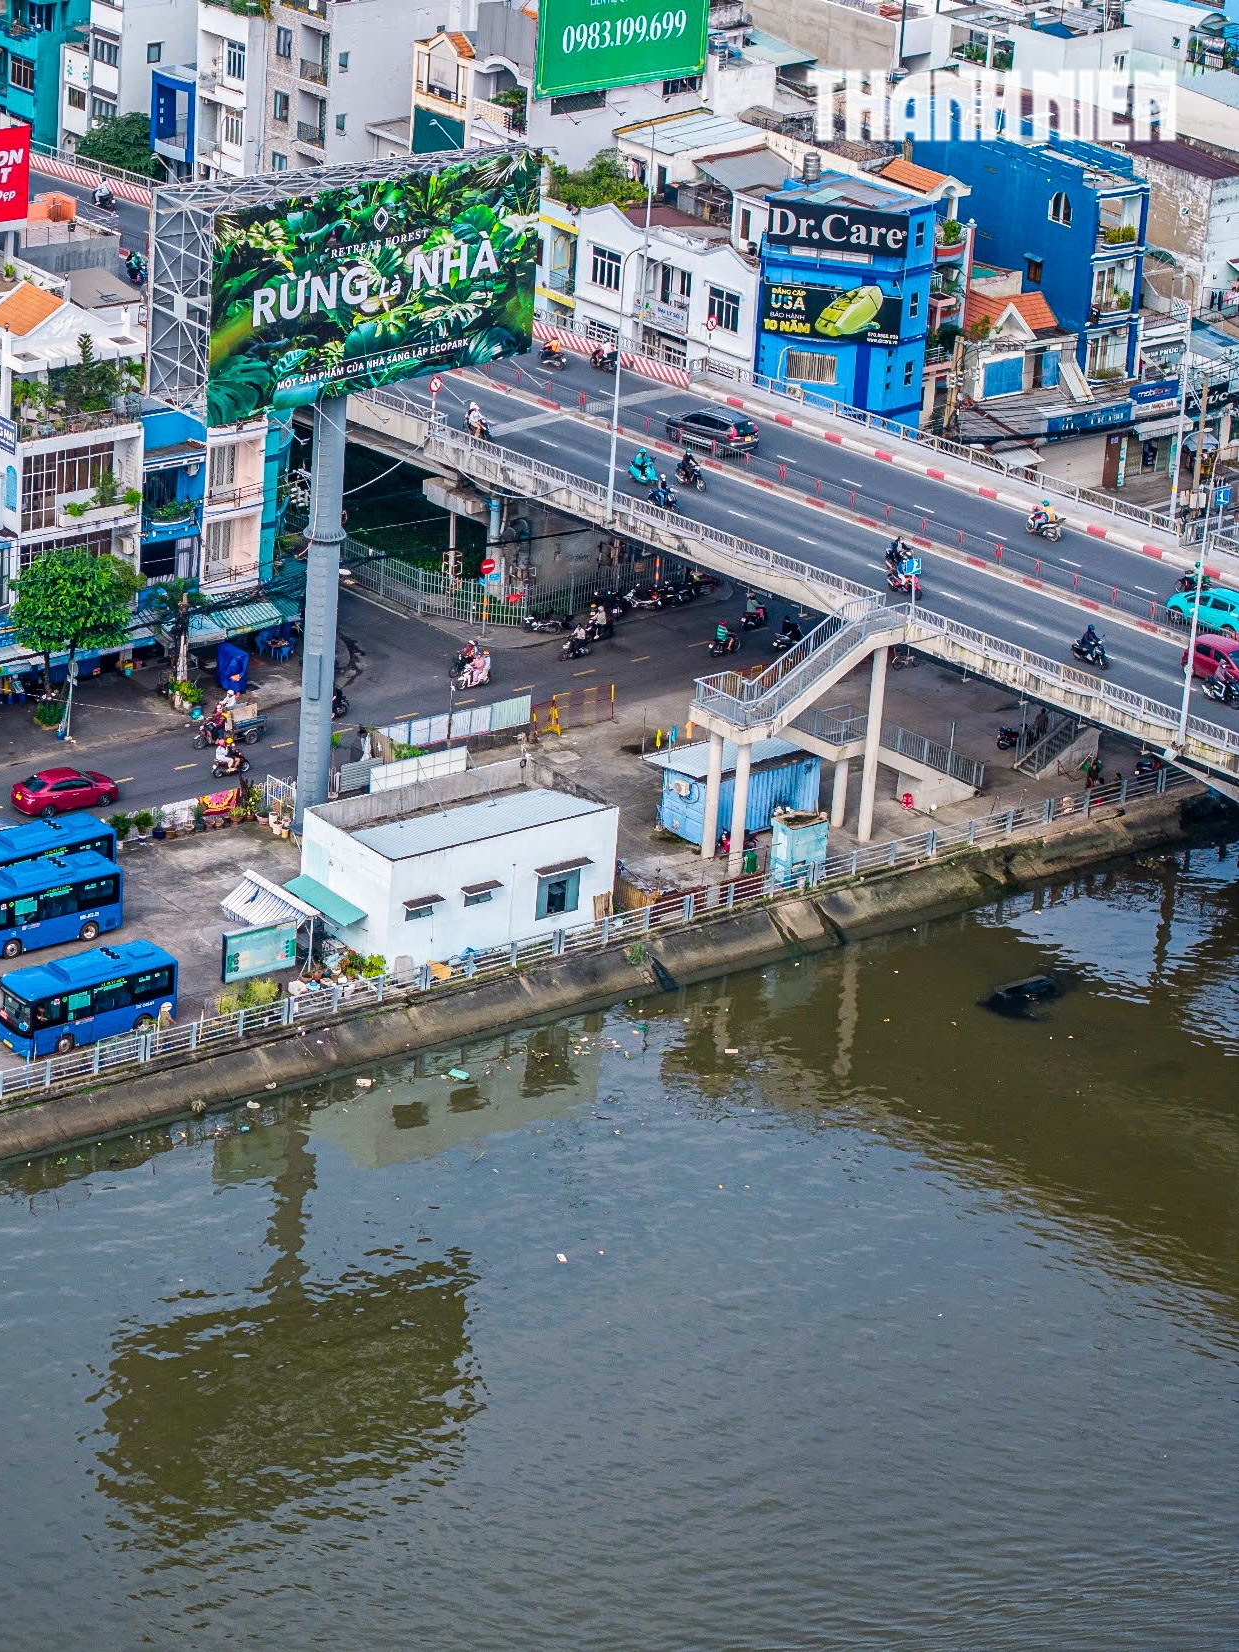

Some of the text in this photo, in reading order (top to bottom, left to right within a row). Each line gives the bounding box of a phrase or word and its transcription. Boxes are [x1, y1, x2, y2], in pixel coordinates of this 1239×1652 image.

[562, 9, 687, 53] 0983.199.699
[330, 229, 428, 259] RETREAT FOREST
[769, 207, 903, 249] Dr.Care
[252, 266, 369, 327] RỪNG
[412, 230, 499, 291] NHÀ
[771, 294, 806, 311] USA
[764, 317, 811, 334] 10 NĂM
[277, 378, 298, 391] MỘT
[346, 361, 365, 374] CỦA
[366, 356, 385, 369] NHÀ
[386, 351, 410, 364] SÁNG
[429, 338, 469, 355] ECOPARK
